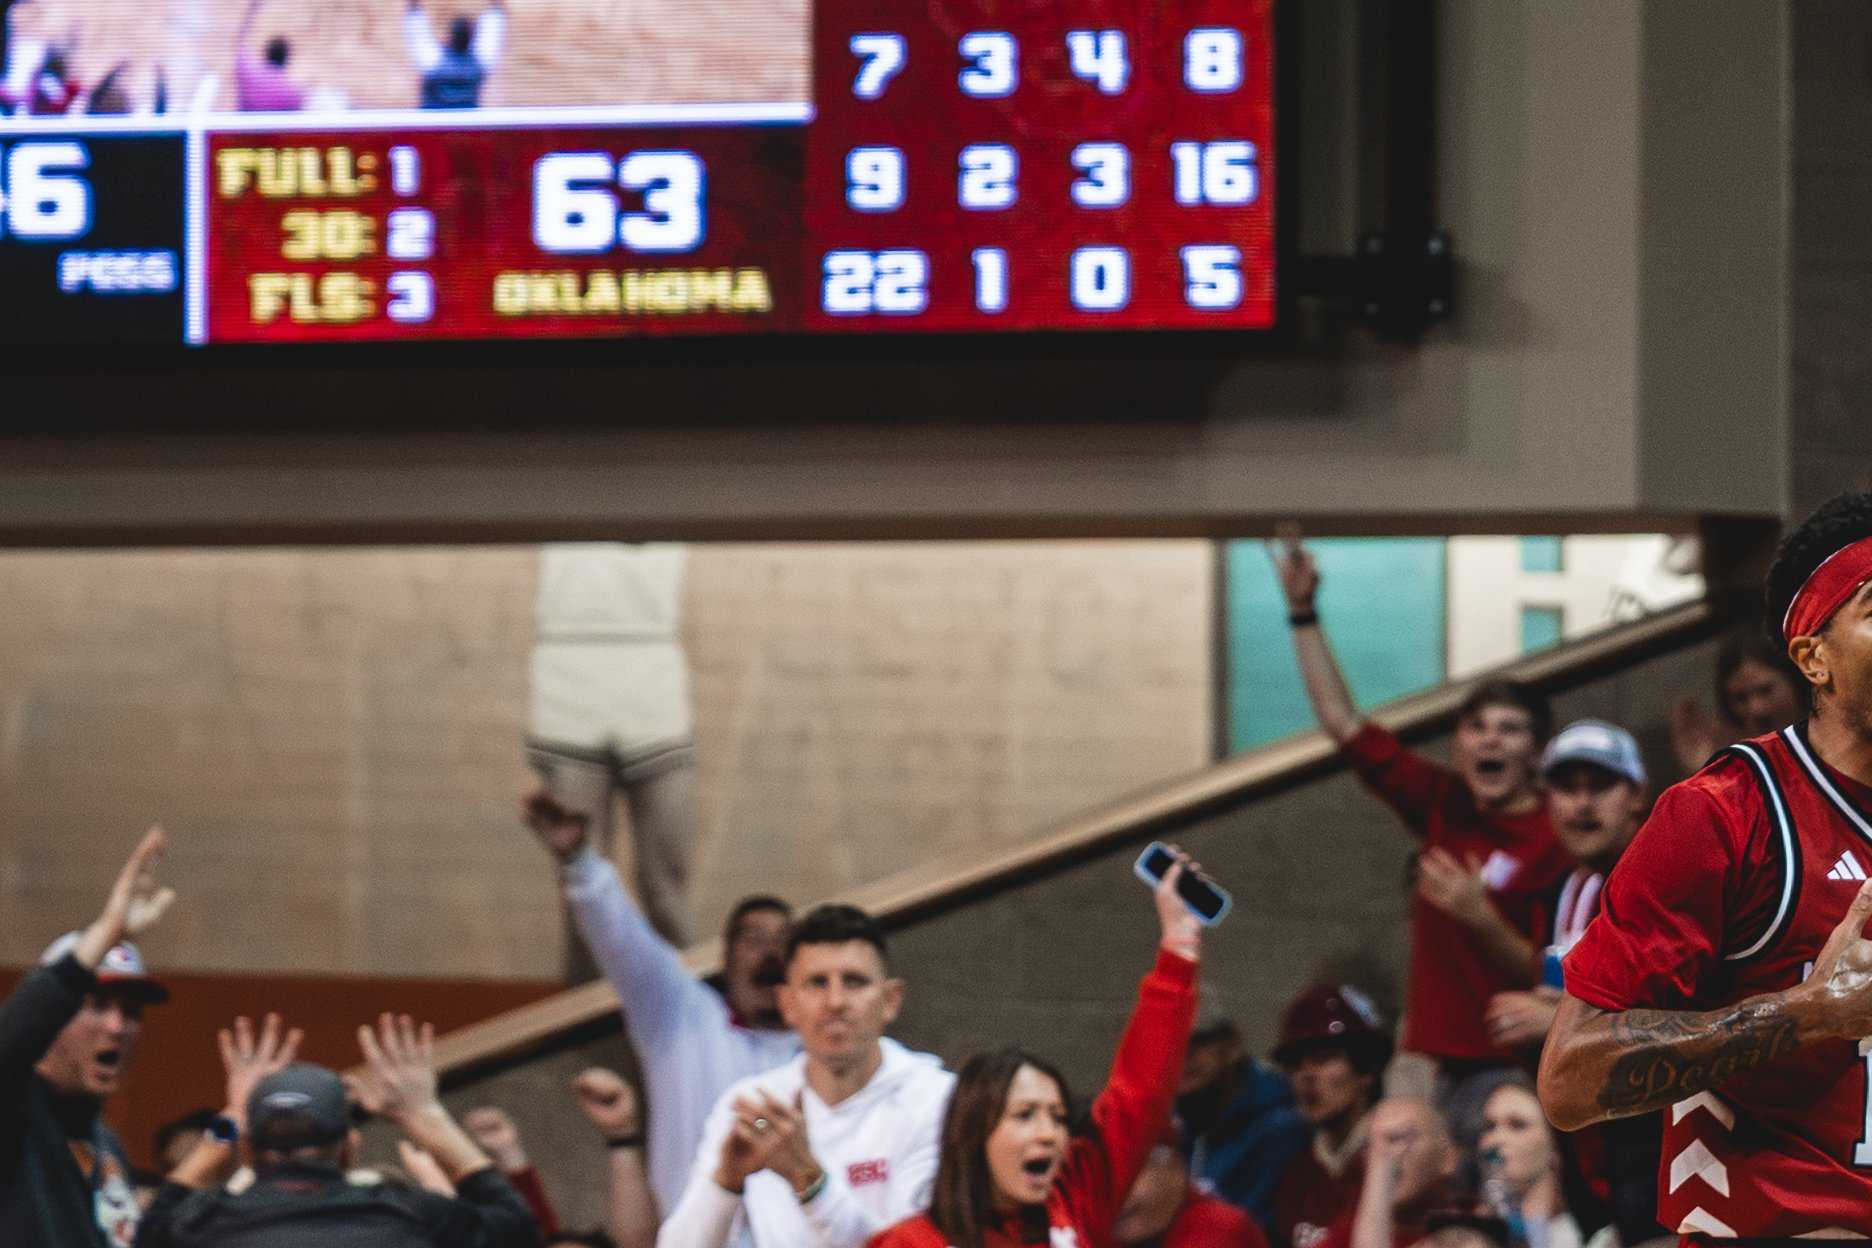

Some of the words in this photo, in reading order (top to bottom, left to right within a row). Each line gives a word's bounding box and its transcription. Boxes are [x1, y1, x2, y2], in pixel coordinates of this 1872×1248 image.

[850, 33, 905, 98] 7
[959, 32, 1017, 95] 3
[1067, 30, 1130, 94] 4
[1183, 28, 1242, 92] 8
[0, 142, 90, 236] 6
[217, 147, 377, 197] FULL:
[389, 146, 420, 195] 1
[534, 151, 708, 252] 63
[846, 147, 905, 210] 9
[959, 145, 1017, 209] 2
[1071, 143, 1130, 207] 3
[1171, 141, 1256, 205] 16
[281, 211, 377, 260] 30:
[387, 210, 434, 258] 2
[249, 273, 377, 323] FLS:
[388, 272, 434, 321] 3
[493, 268, 772, 315] OKLAHOMA
[823, 250, 927, 314] 22
[972, 248, 1008, 312] 1
[1070, 247, 1130, 310] 0
[1180, 246, 1242, 308] 5
